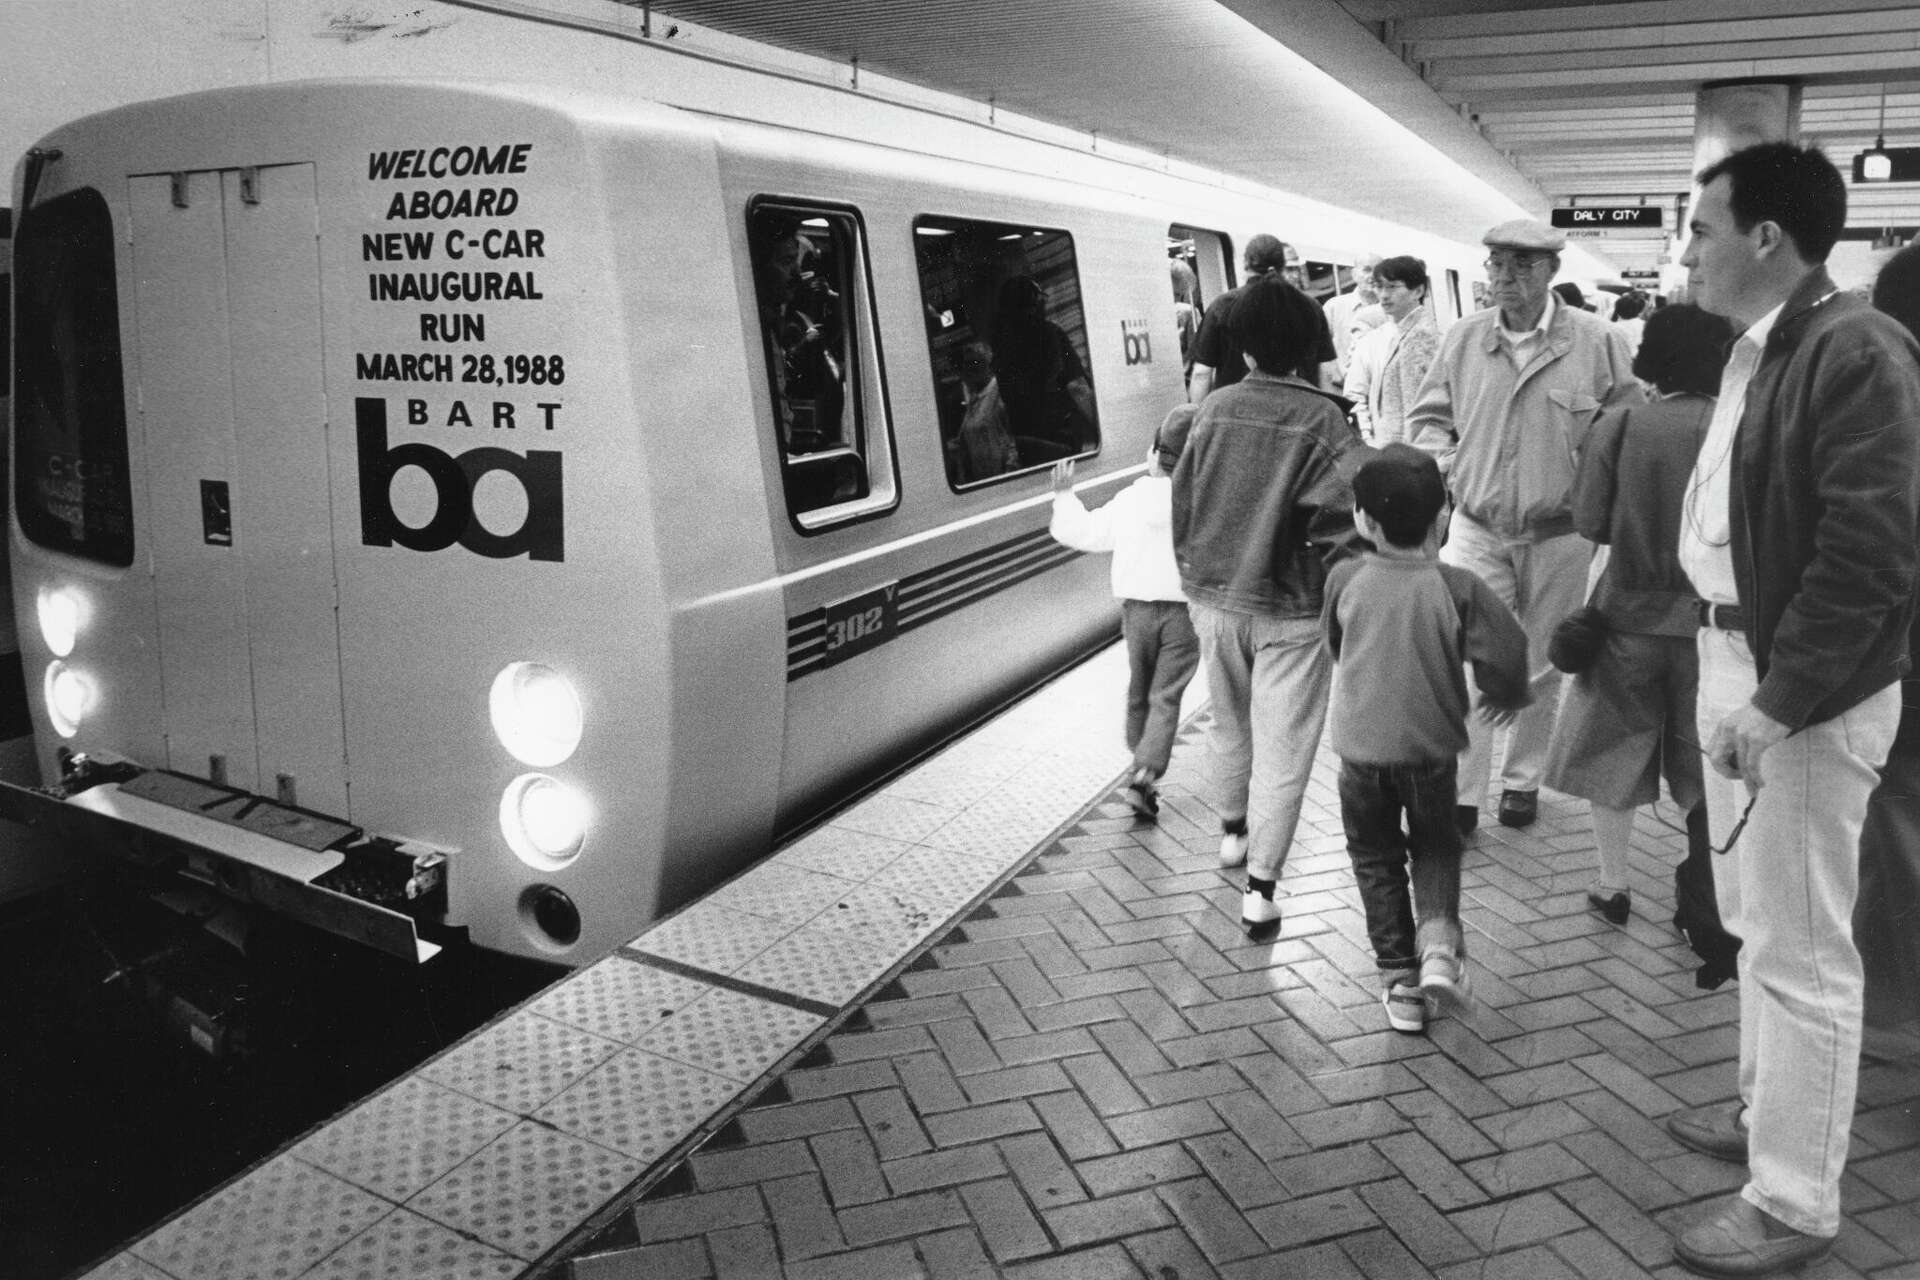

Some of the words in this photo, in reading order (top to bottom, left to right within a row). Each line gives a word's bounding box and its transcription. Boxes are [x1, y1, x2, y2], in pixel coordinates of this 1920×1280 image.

[369, 144, 532, 180] WELCOME
[386, 187, 518, 220] ABOARD
[1573, 210, 1605, 221] DALY
[1612, 209, 1640, 220] CITY
[362, 232, 434, 261] NEW
[445, 228, 545, 260] C-CAR
[369, 271, 543, 302] INAUGURAL
[420, 313, 485, 343] RUN
[356, 353, 453, 382] MARCH
[461, 354, 565, 387] 28,1988
[408, 399, 562, 430] BART
[827, 606, 883, 650] 302
